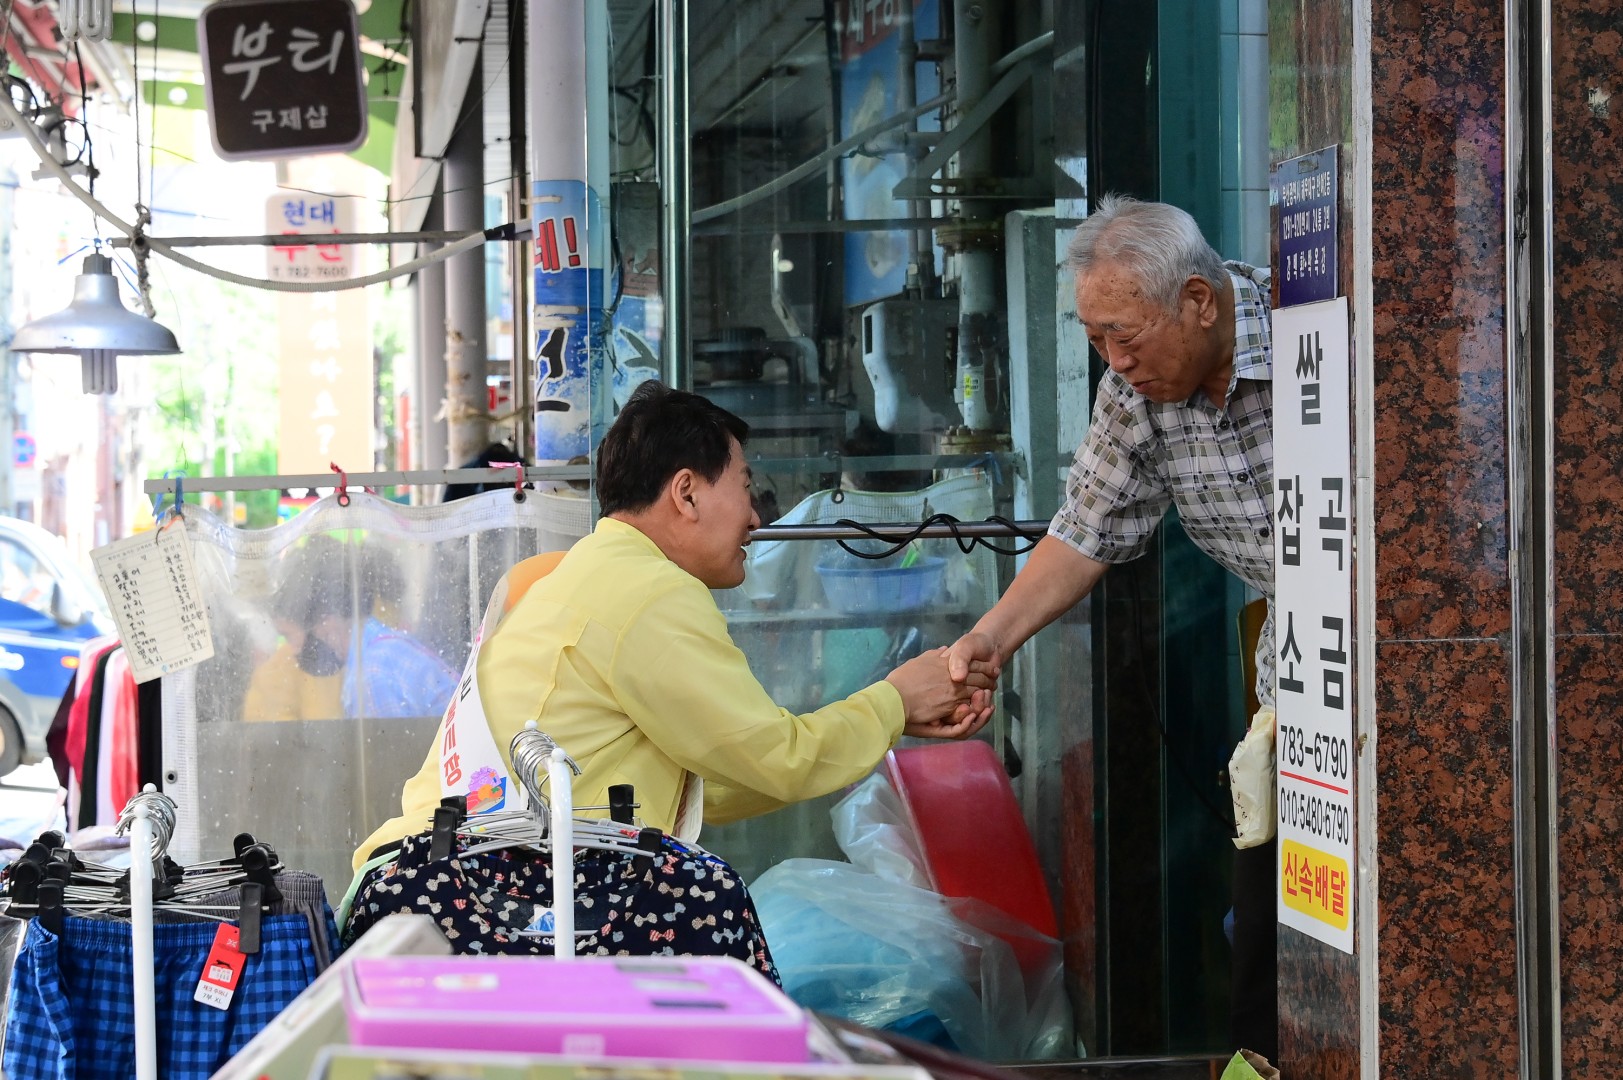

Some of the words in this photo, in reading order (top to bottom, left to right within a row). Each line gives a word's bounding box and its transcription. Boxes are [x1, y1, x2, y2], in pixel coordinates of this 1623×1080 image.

[283, 199, 336, 226] 현대
[1295, 331, 1323, 426] 쌀
[1279, 611, 1347, 710] 소금
[1280, 724, 1348, 780] 783-6790
[1284, 851, 1346, 917] 신속배달
